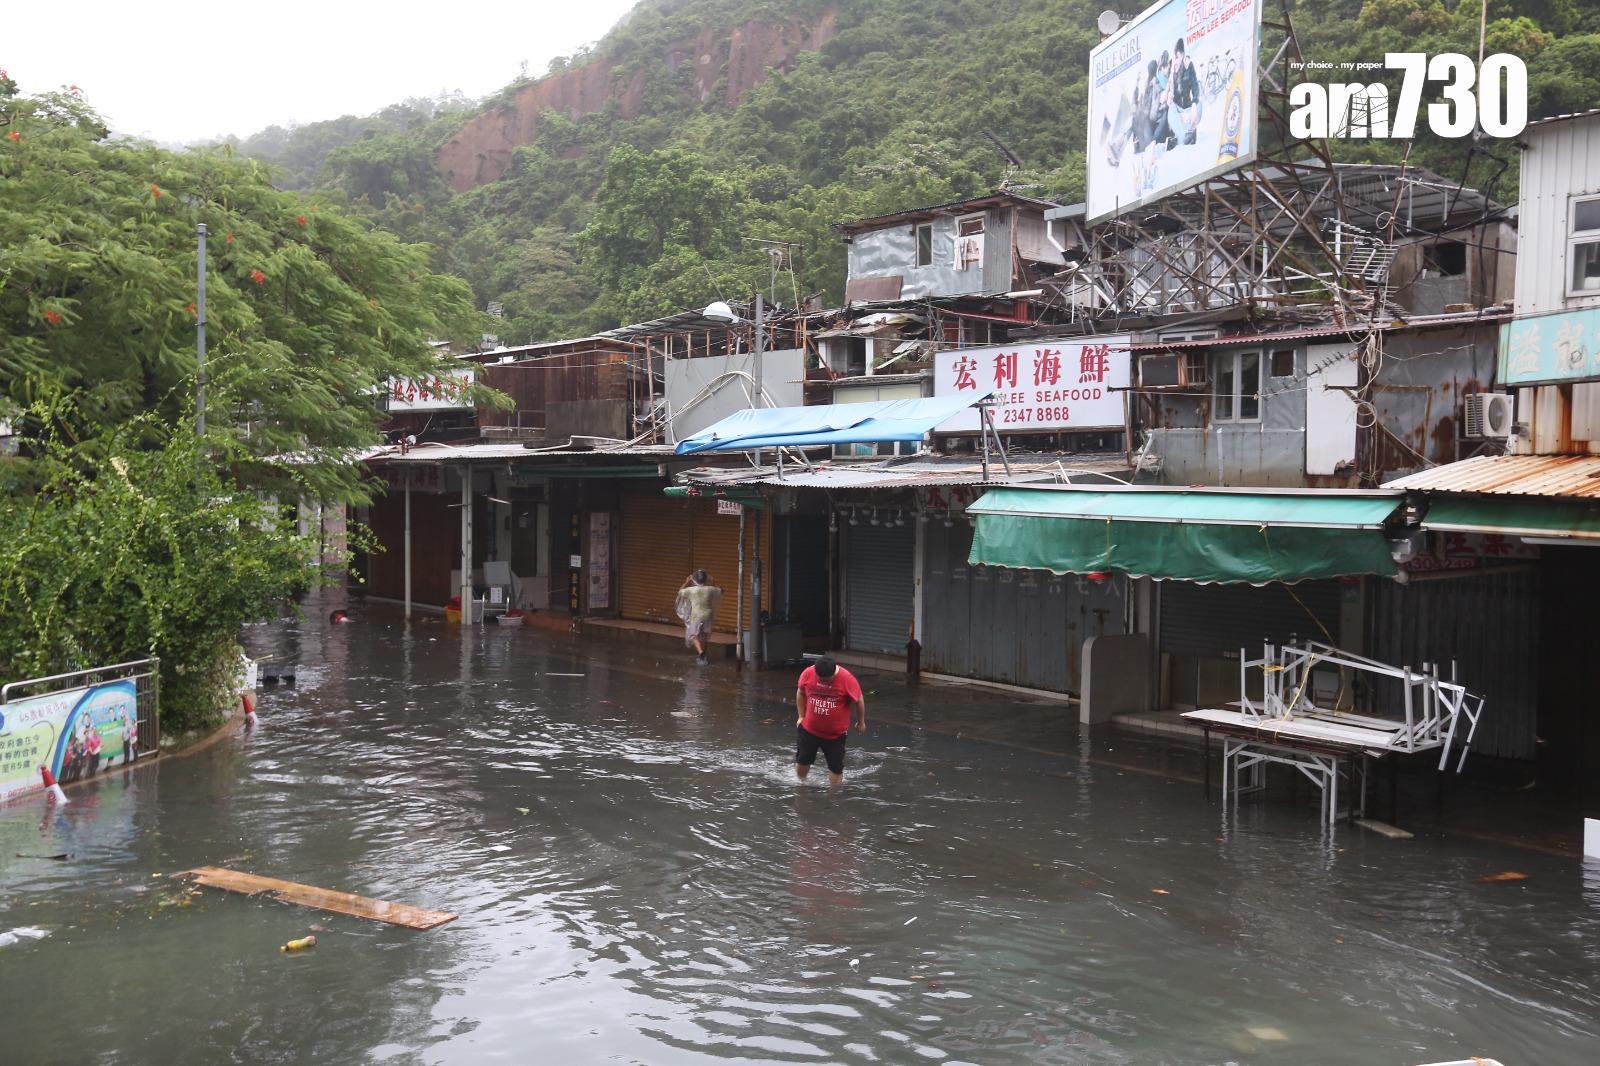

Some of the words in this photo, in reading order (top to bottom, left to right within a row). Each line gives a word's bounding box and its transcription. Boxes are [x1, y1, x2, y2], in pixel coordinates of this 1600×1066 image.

[1207, 17, 1219, 33] LEE
[1096, 50, 1117, 78] BLUE
[1119, 35, 1141, 62] GIRL
[952, 343, 1111, 392] 宏利海鮮
[1035, 388, 1102, 403] SEAFOOD
[1003, 408, 1033, 423] 2347
[1036, 406, 1070, 422] 8868
